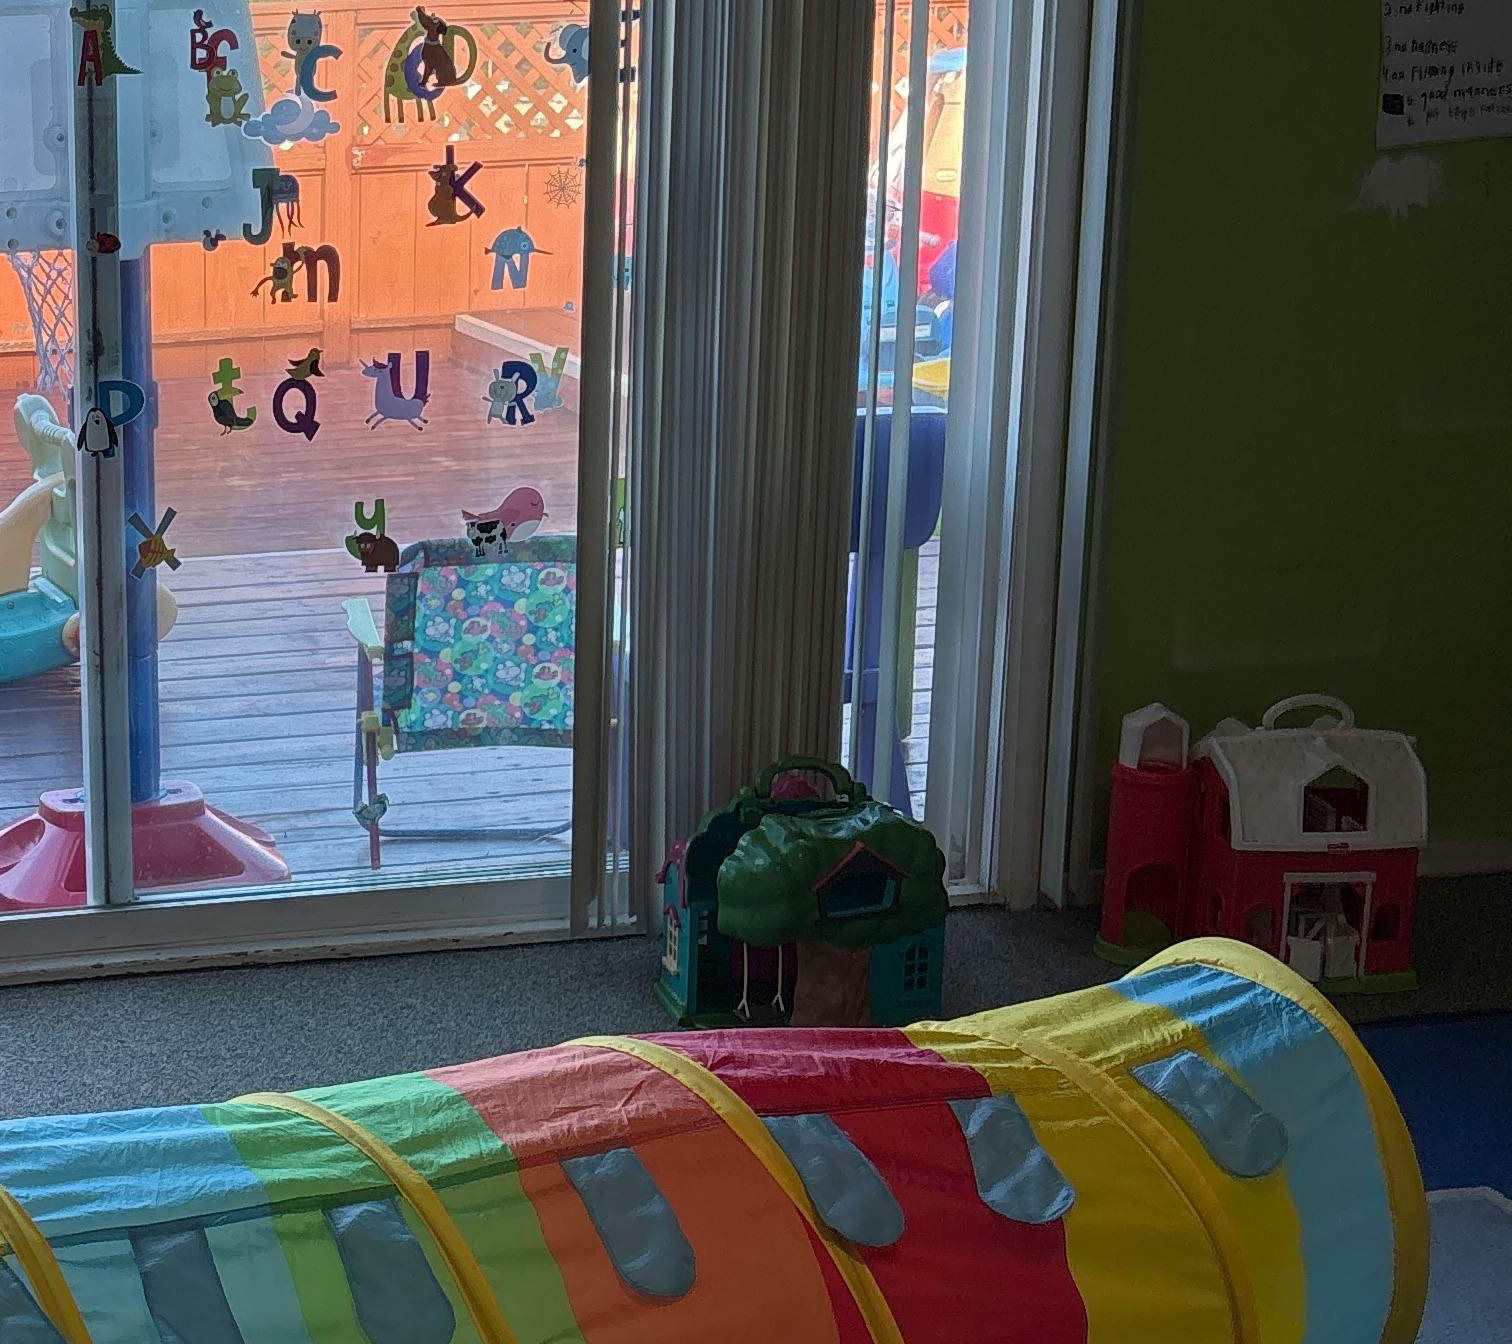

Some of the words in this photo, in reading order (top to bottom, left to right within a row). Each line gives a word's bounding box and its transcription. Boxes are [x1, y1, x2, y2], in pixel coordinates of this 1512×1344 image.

[78, 30, 103, 86] A
[190, 29, 216, 71] B
[301, 44, 343, 102] C
[243, 168, 280, 246] J
[272, 378, 321, 442] Q
[502, 360, 538, 425] R
